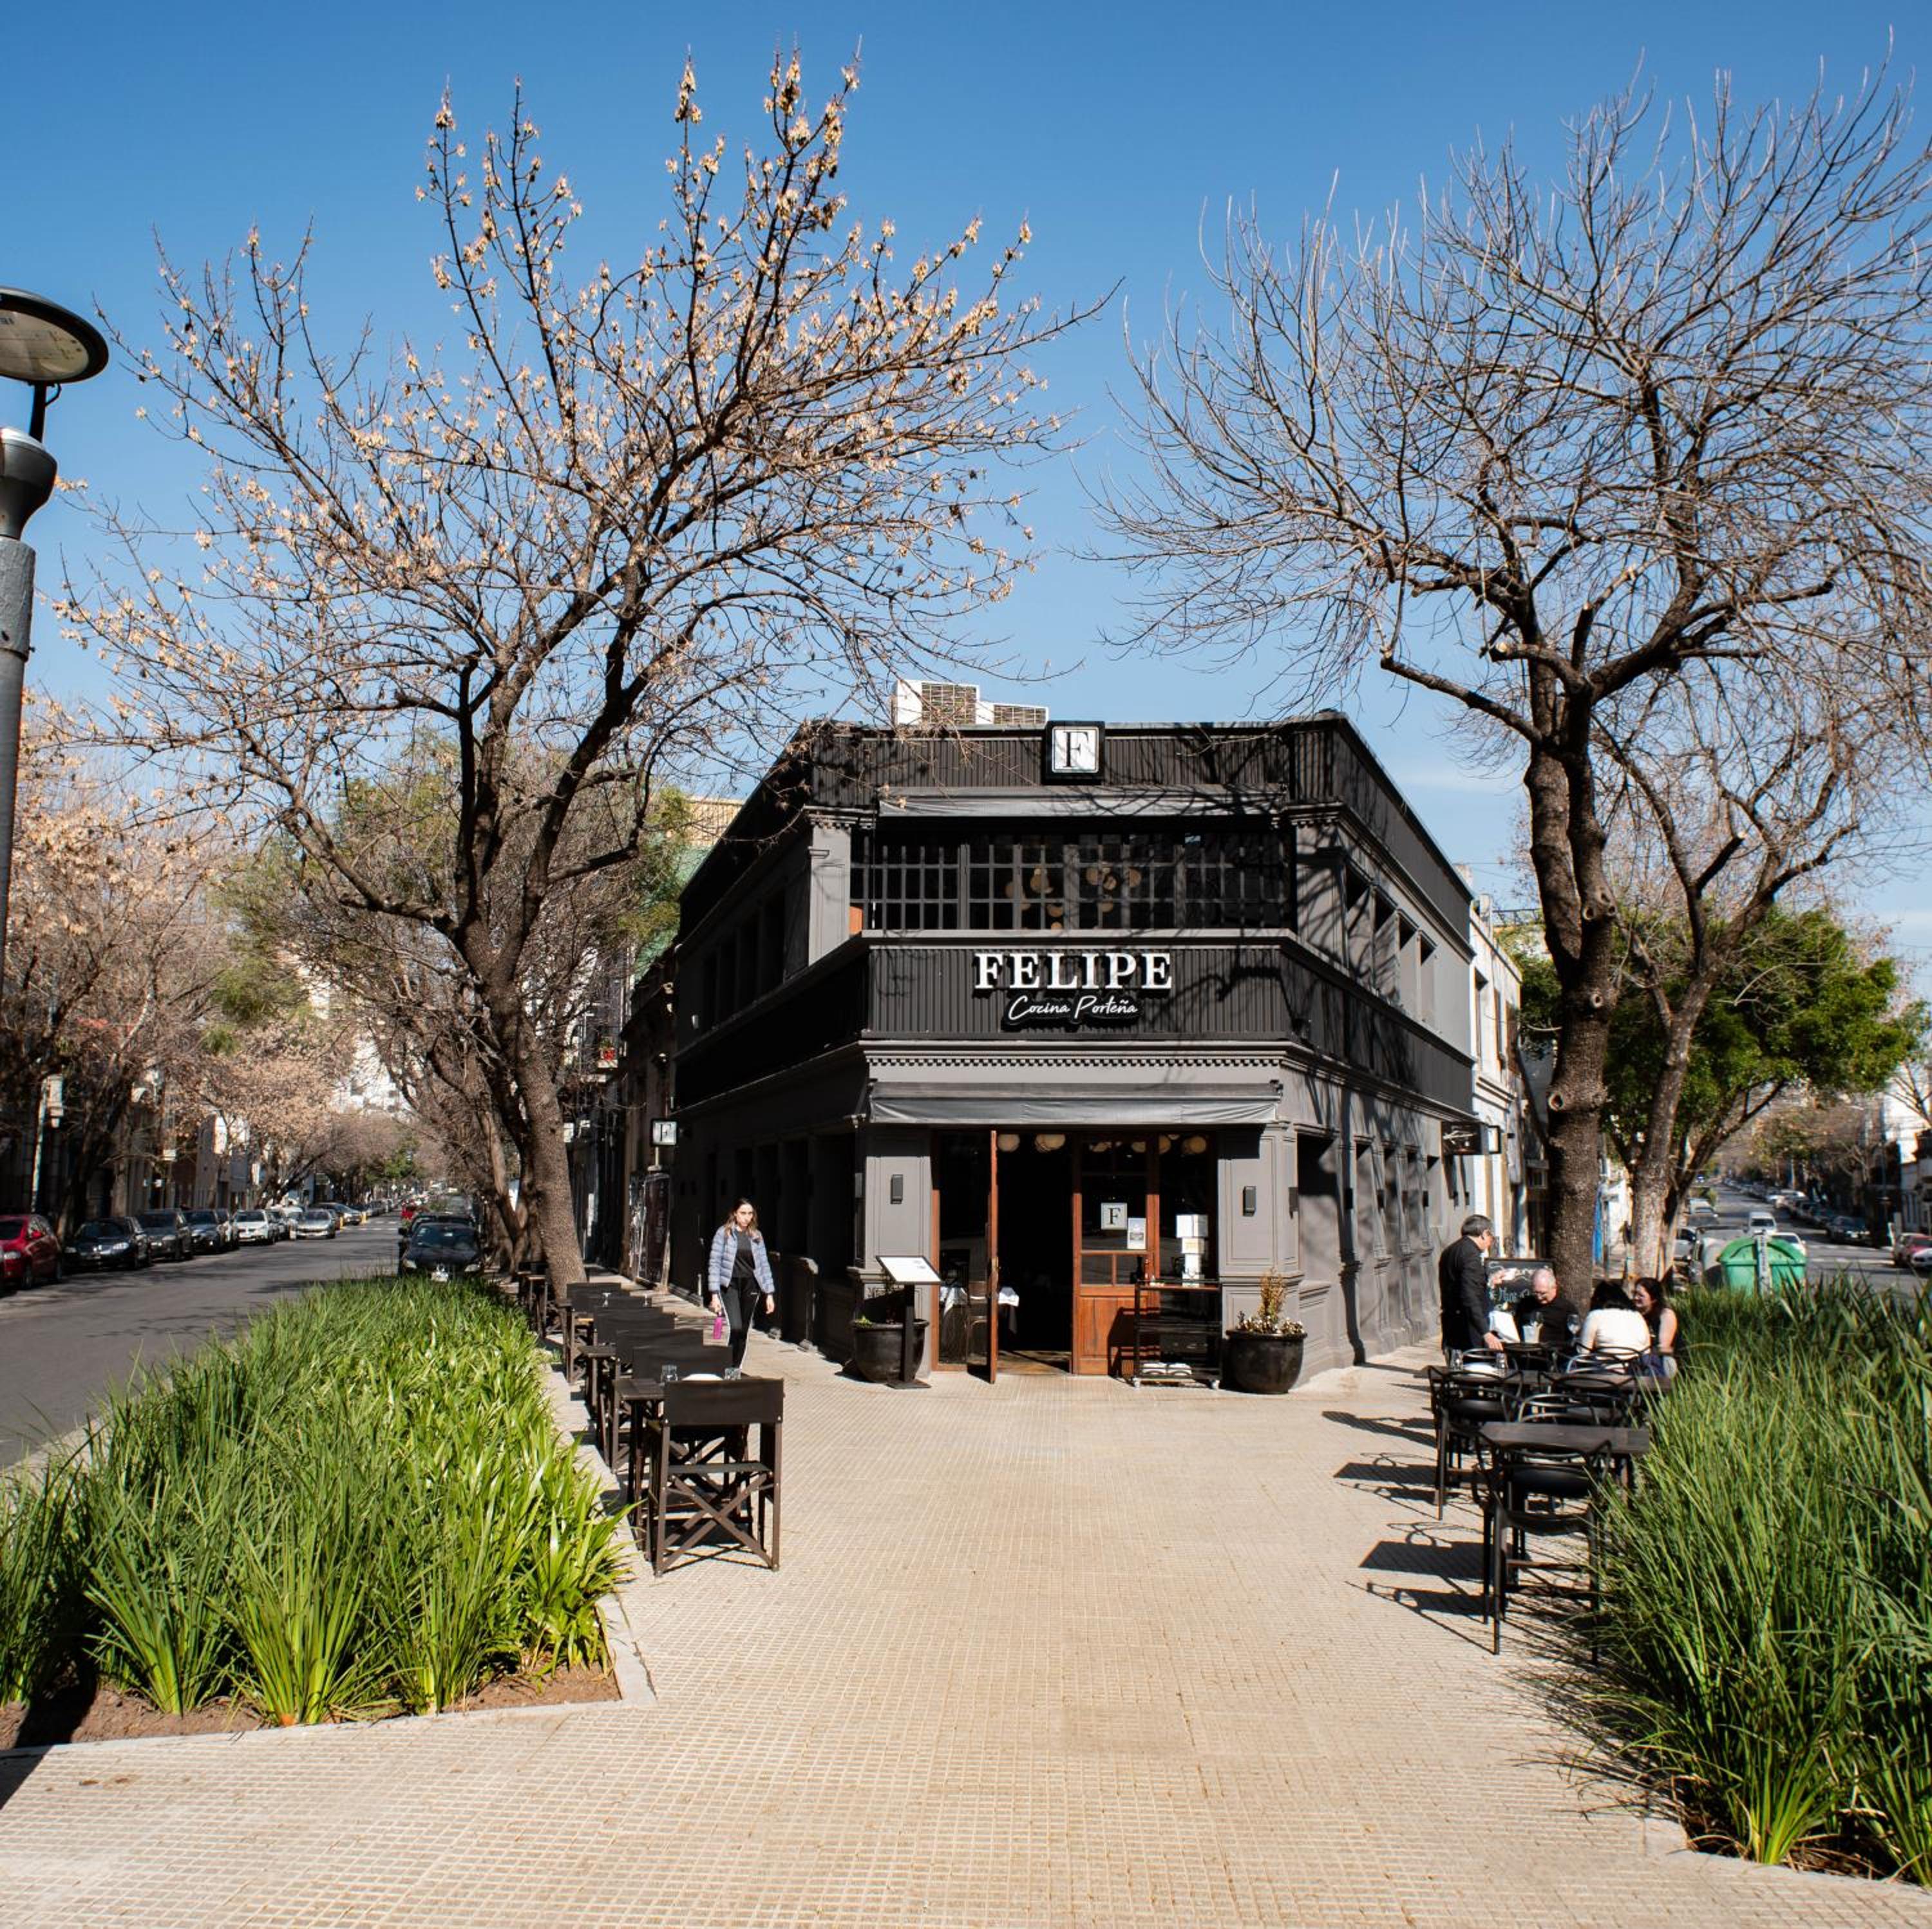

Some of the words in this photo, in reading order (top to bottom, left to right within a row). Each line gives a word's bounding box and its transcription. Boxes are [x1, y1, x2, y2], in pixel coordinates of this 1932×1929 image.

[1063, 731, 1088, 768] F
[974, 952, 1172, 990] FELIPE
[1009, 995, 1070, 1020] Cocina
[1074, 995, 1138, 1019] Porteña
[658, 1124, 671, 1142] F
[1107, 1207, 1121, 1225] F
